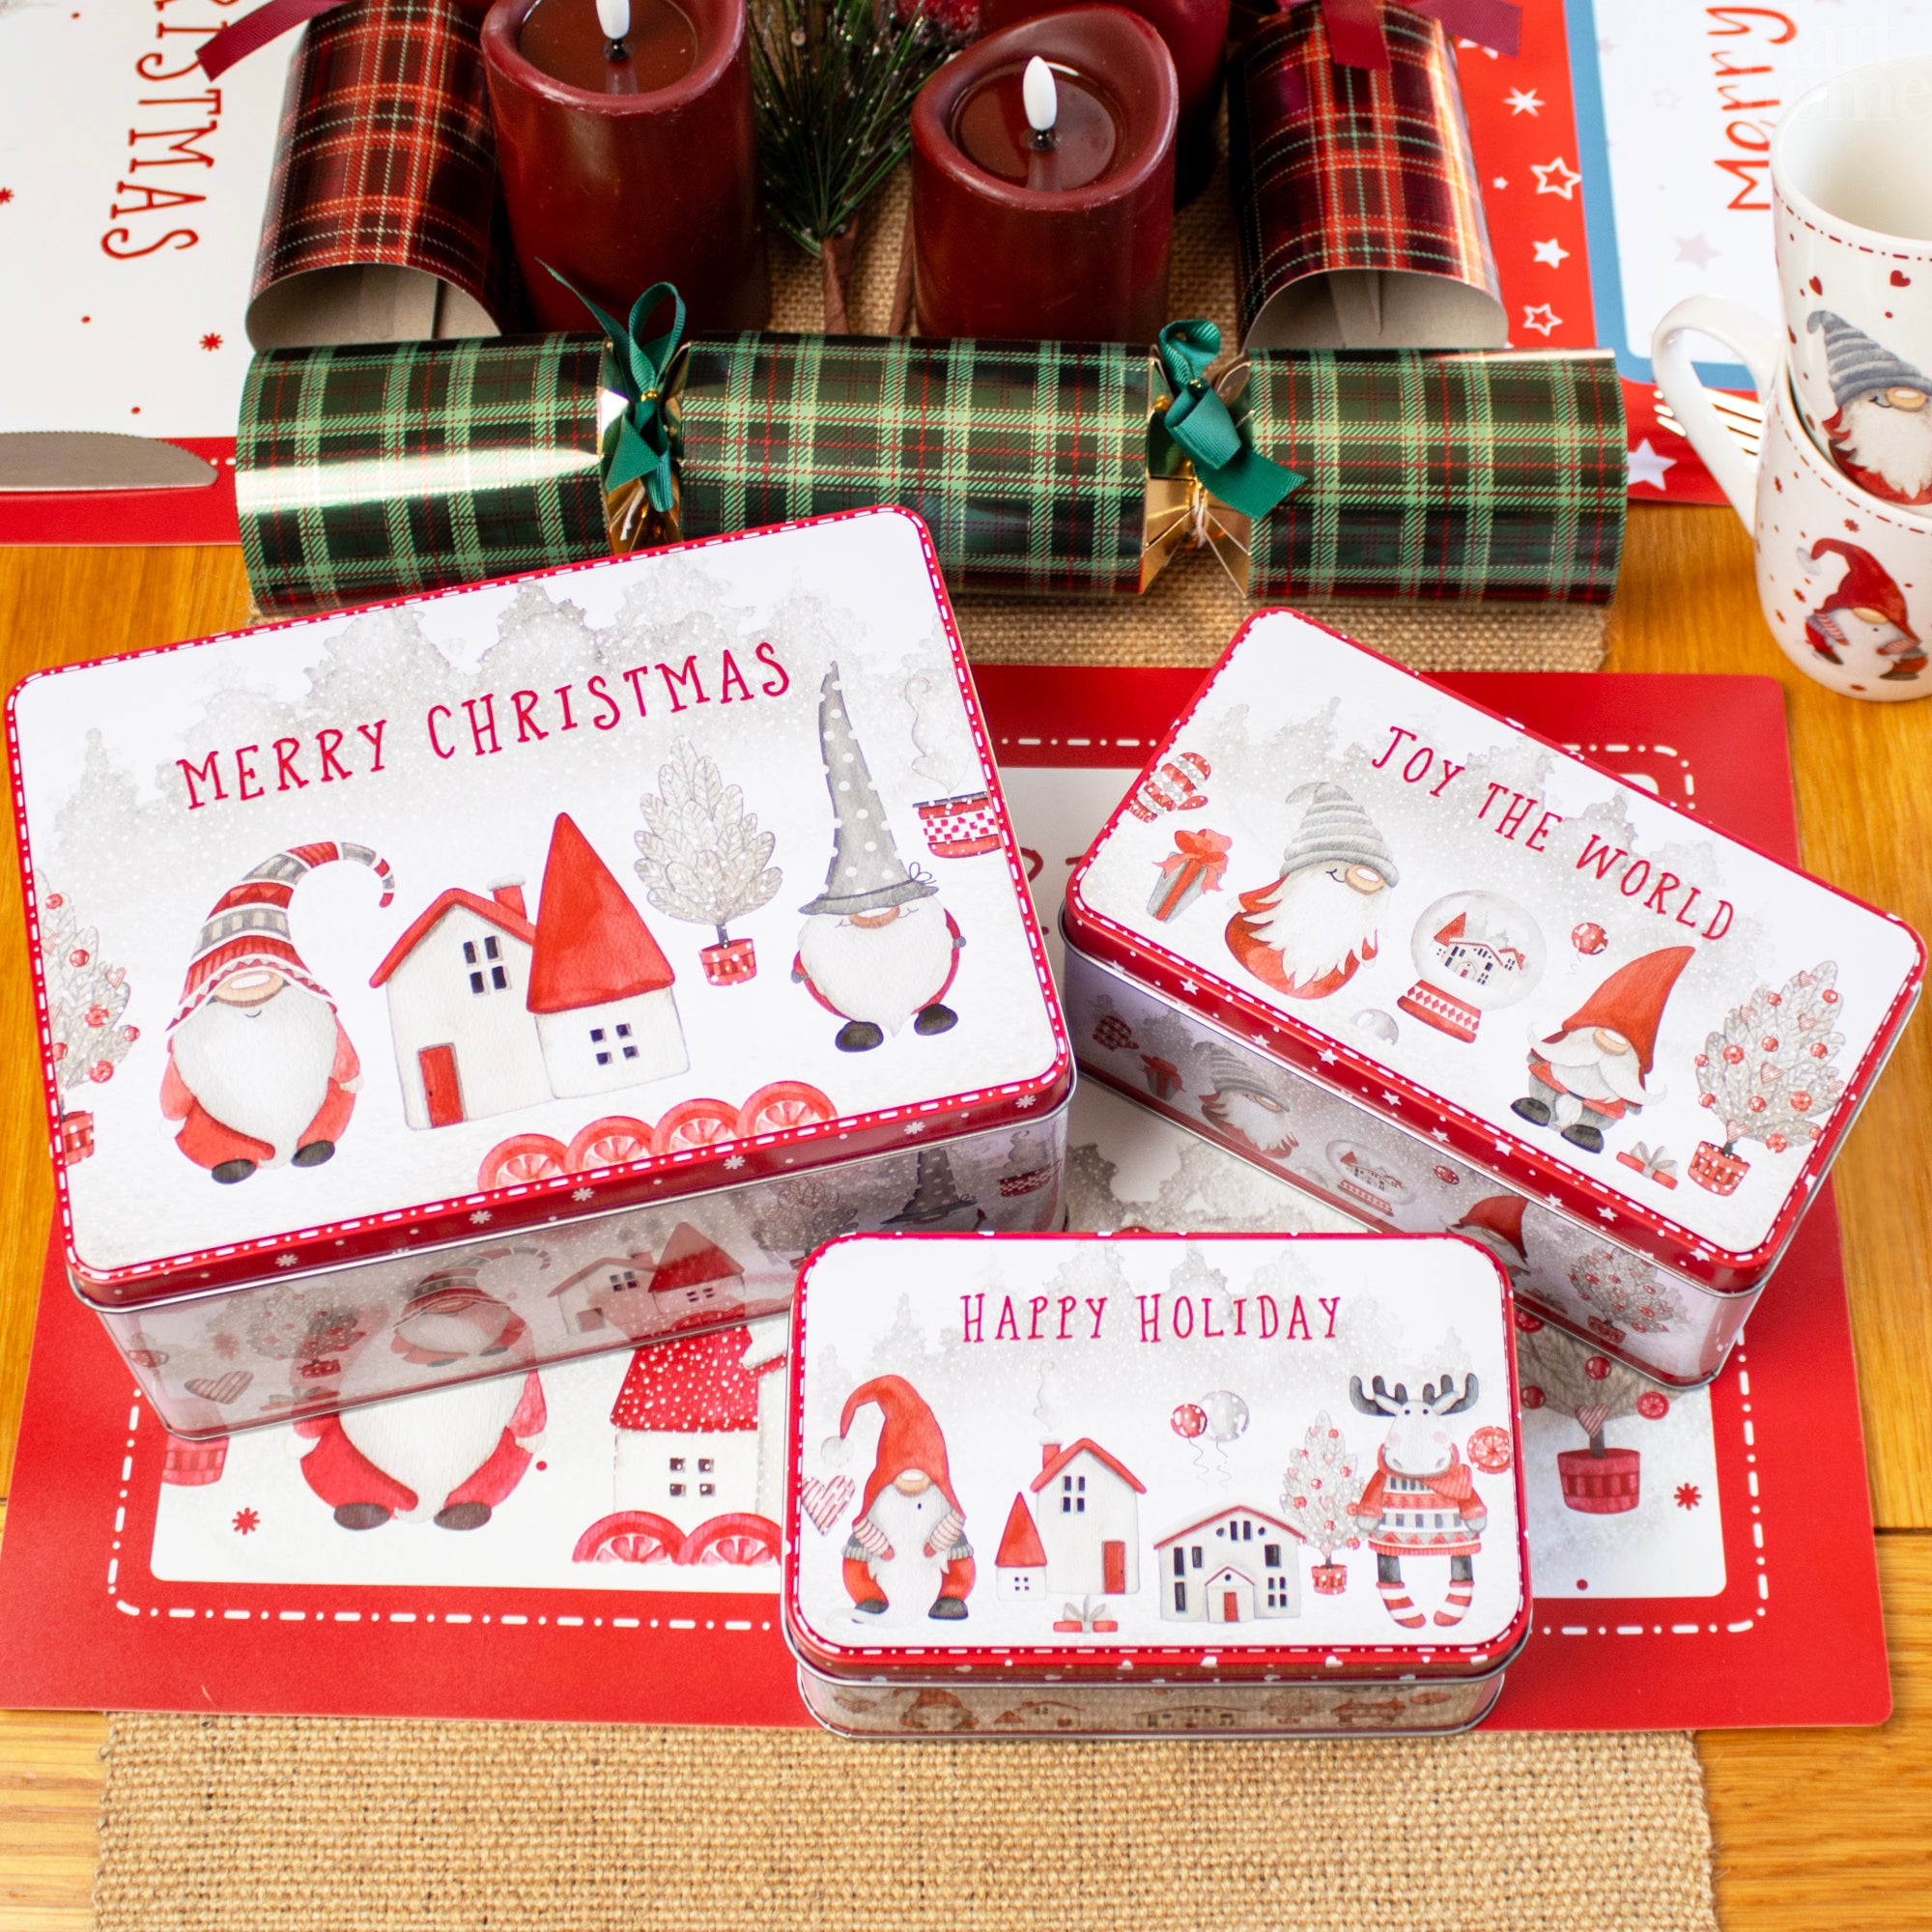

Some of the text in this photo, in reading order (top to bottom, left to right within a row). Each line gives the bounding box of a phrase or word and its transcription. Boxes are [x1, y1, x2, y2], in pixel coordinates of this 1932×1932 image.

[1706, 6, 1797, 211] Merry
[175, 640, 790, 810] MERRY CHRISTMAS
[1371, 725, 1734, 941] JOY THE WORLD
[960, 1293, 1341, 1344] HAPPY HOLIDAY
